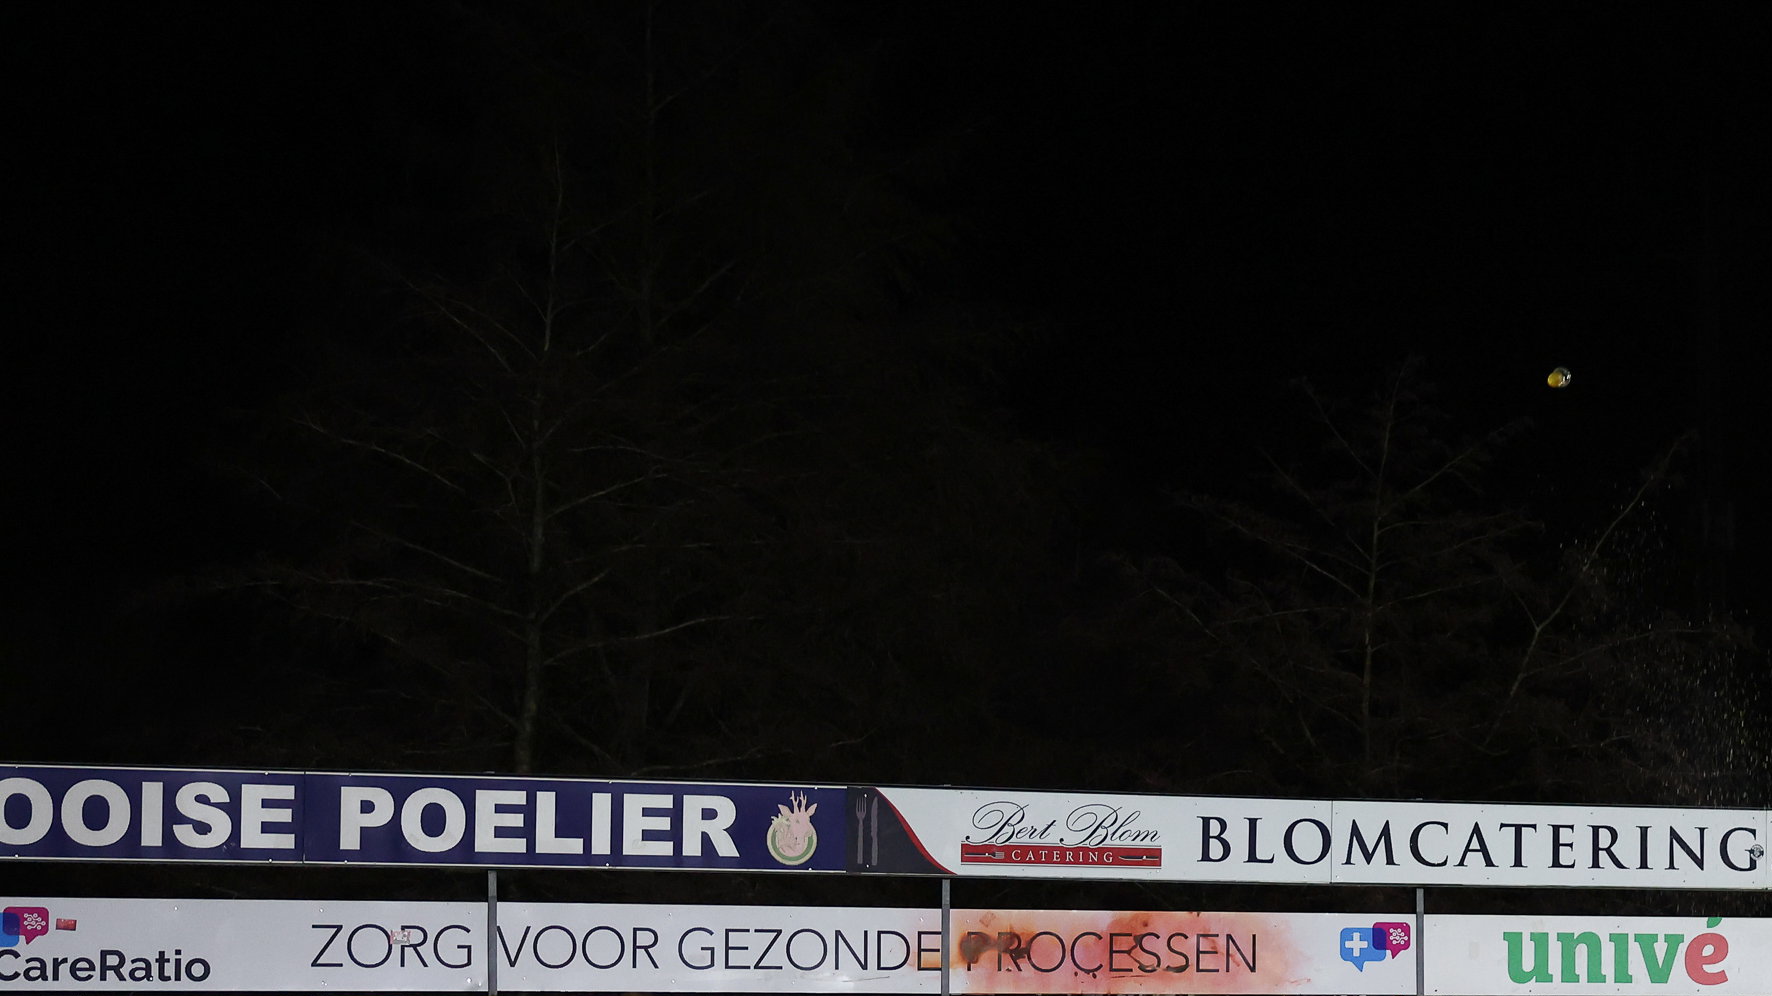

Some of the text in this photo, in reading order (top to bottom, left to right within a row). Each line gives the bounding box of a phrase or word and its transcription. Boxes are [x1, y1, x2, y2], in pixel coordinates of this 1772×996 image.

[339, 785, 741, 859] POELIER
[965, 801, 1162, 848] Bert Blom
[1011, 848, 1114, 866] CATERING
[0, 948, 212, 984] CareRatio
[311, 923, 1258, 974] ZORG VOOR GEZONDE PROCESSEN
[1502, 916, 1729, 986] univé
